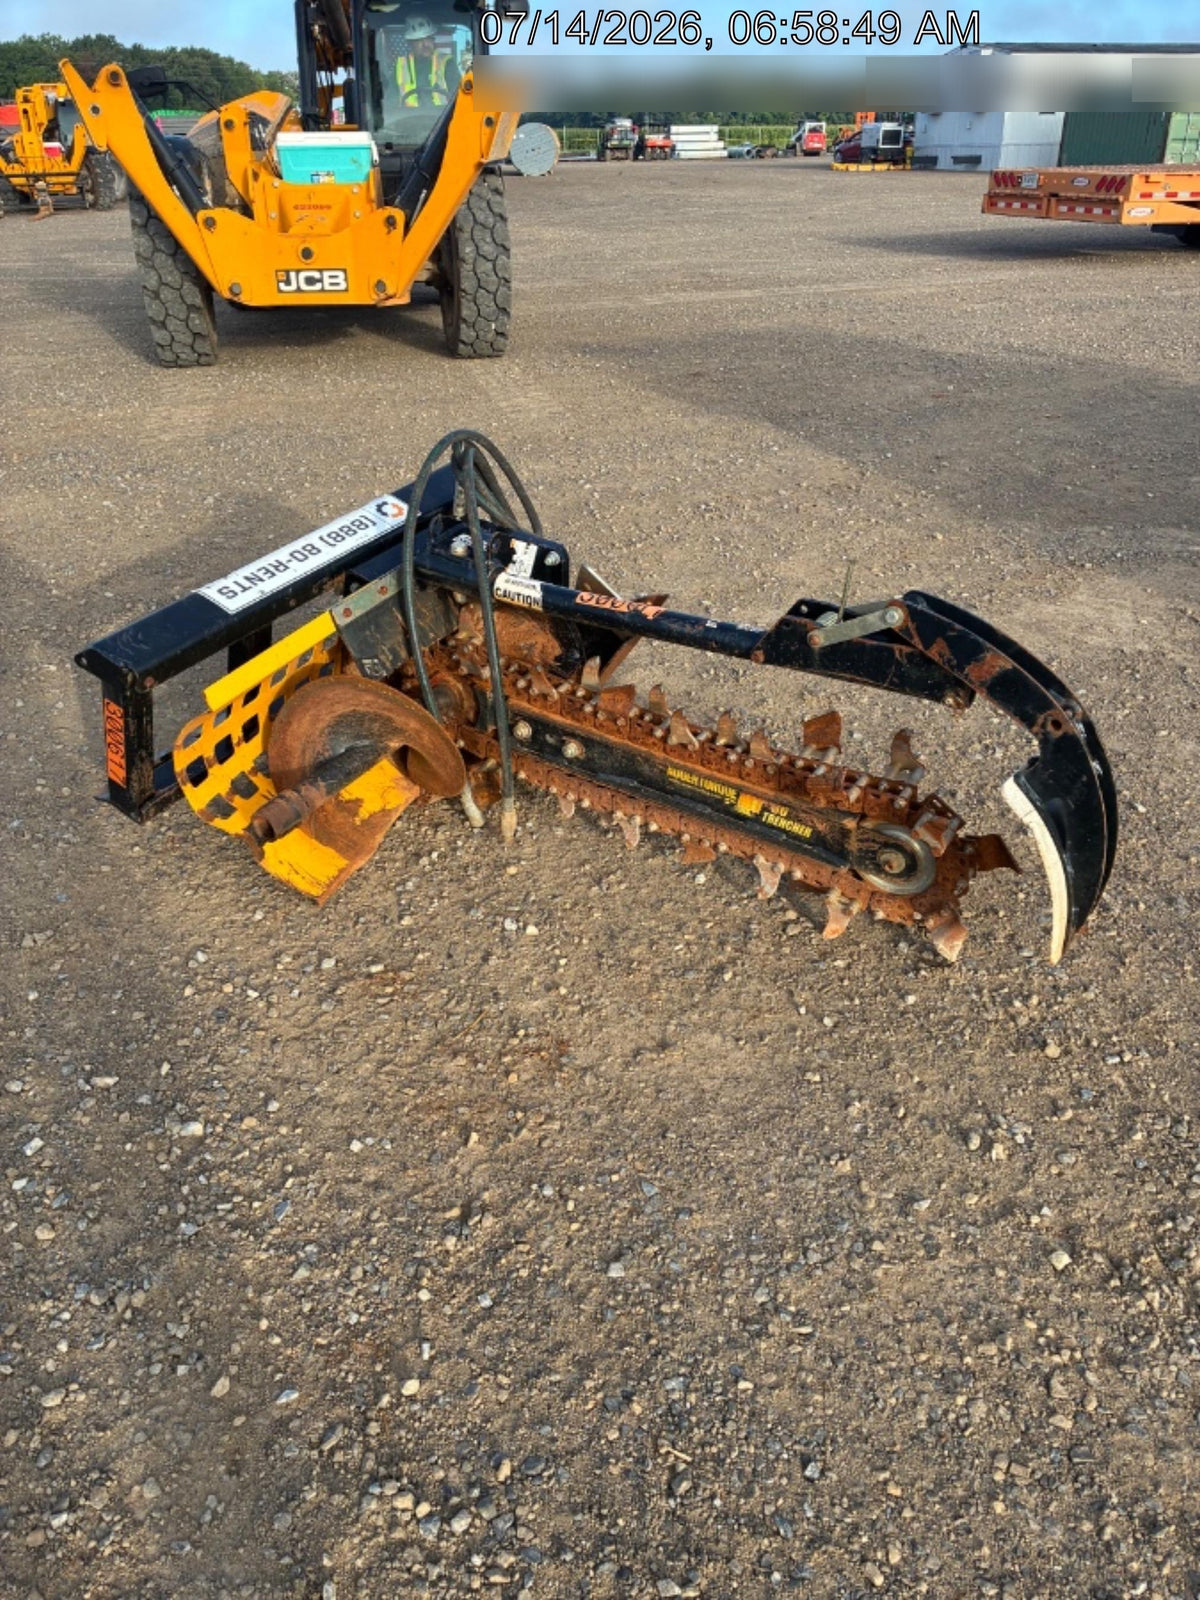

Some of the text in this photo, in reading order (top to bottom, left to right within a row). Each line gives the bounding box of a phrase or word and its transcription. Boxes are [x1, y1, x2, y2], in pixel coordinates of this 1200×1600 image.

[278, 270, 347, 292] JCB
[216, 514, 378, 600] (888) 80-RENTS
[494, 587, 541, 608] CAUTION
